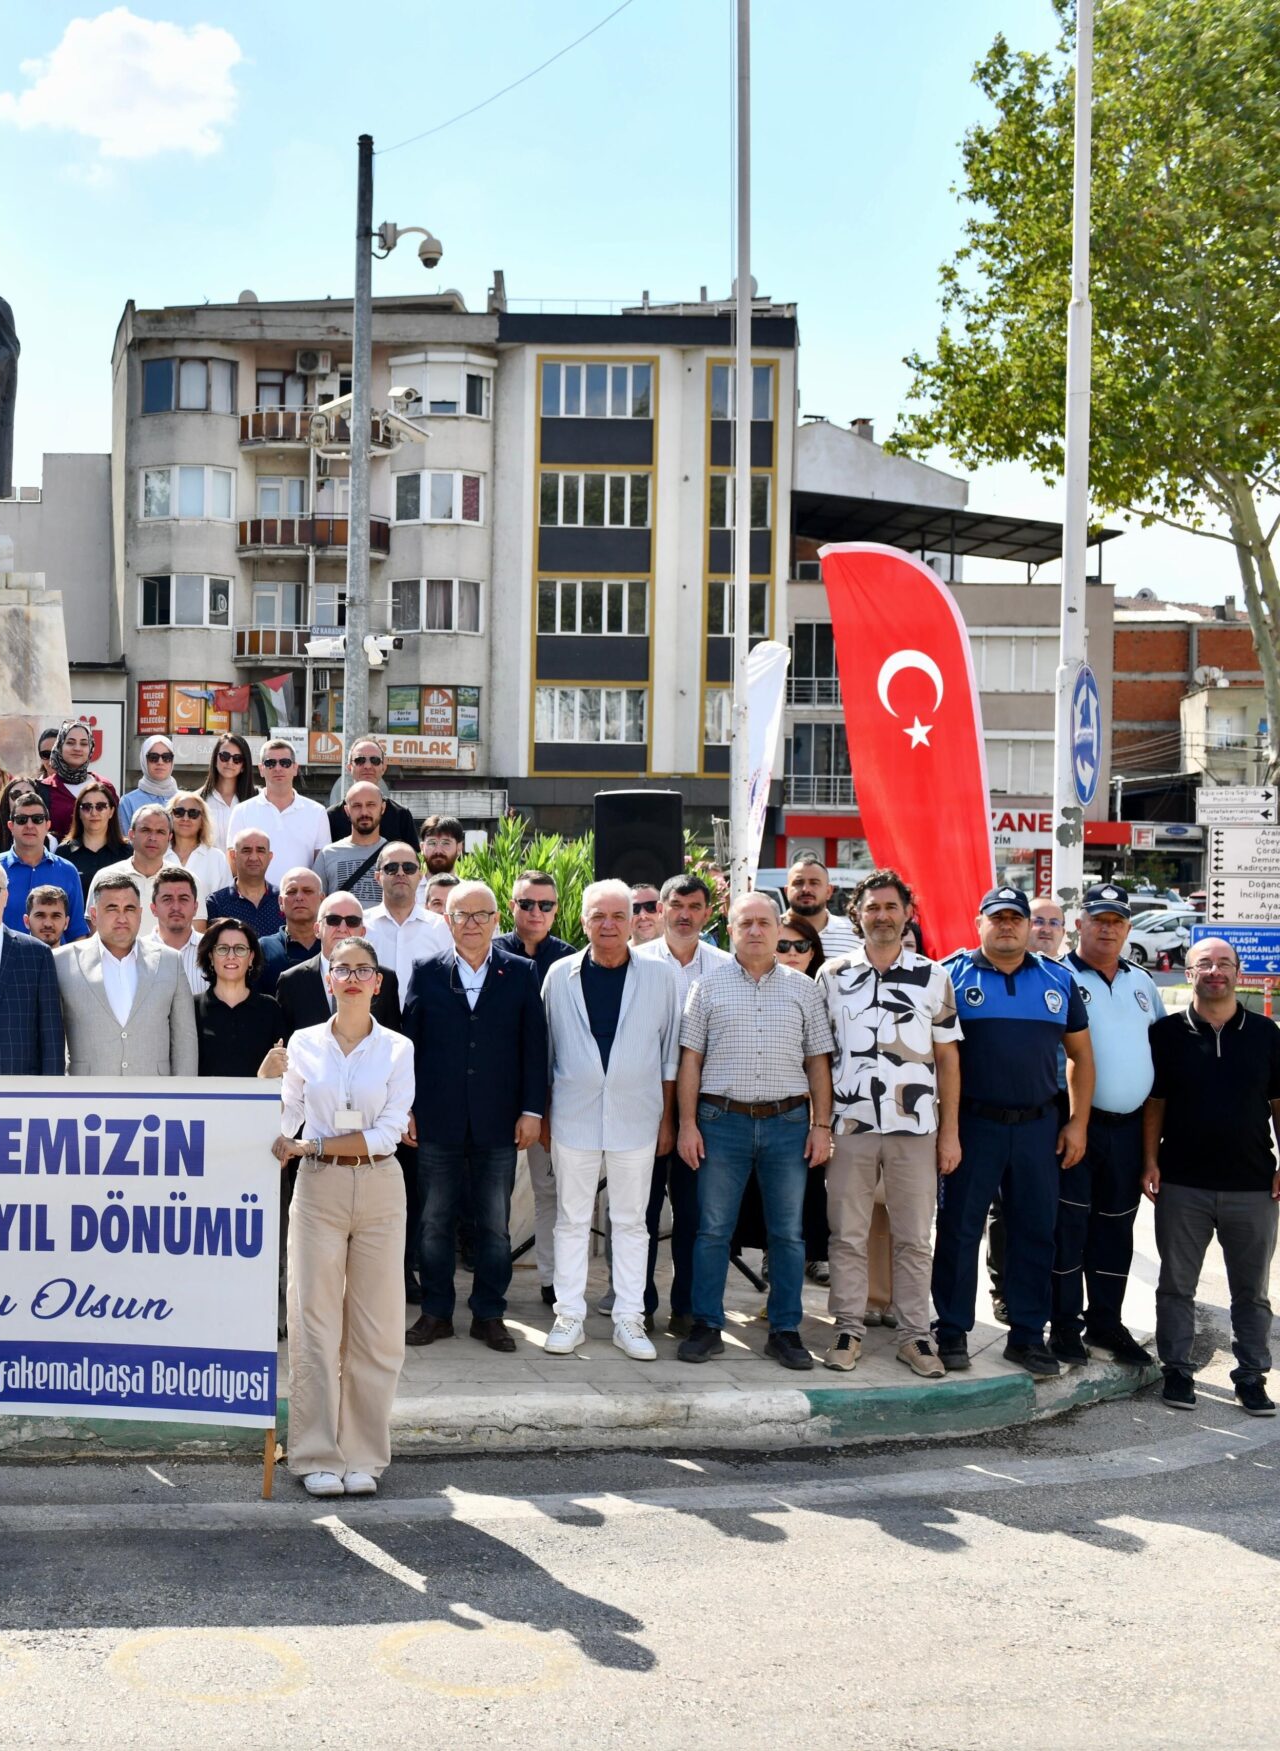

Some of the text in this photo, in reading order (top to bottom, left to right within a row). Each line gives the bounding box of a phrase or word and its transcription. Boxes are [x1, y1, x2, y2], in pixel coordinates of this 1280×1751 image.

[393, 740, 452, 755] EMLAK
[1240, 888, 1280, 900] İncilipına
[1229, 936, 1259, 944] ULAŞIM
[71, 1190, 264, 1258] DÖNÜMÜ
[30, 1277, 173, 1321] Olsun
[151, 1360, 270, 1404] Belediyesi
